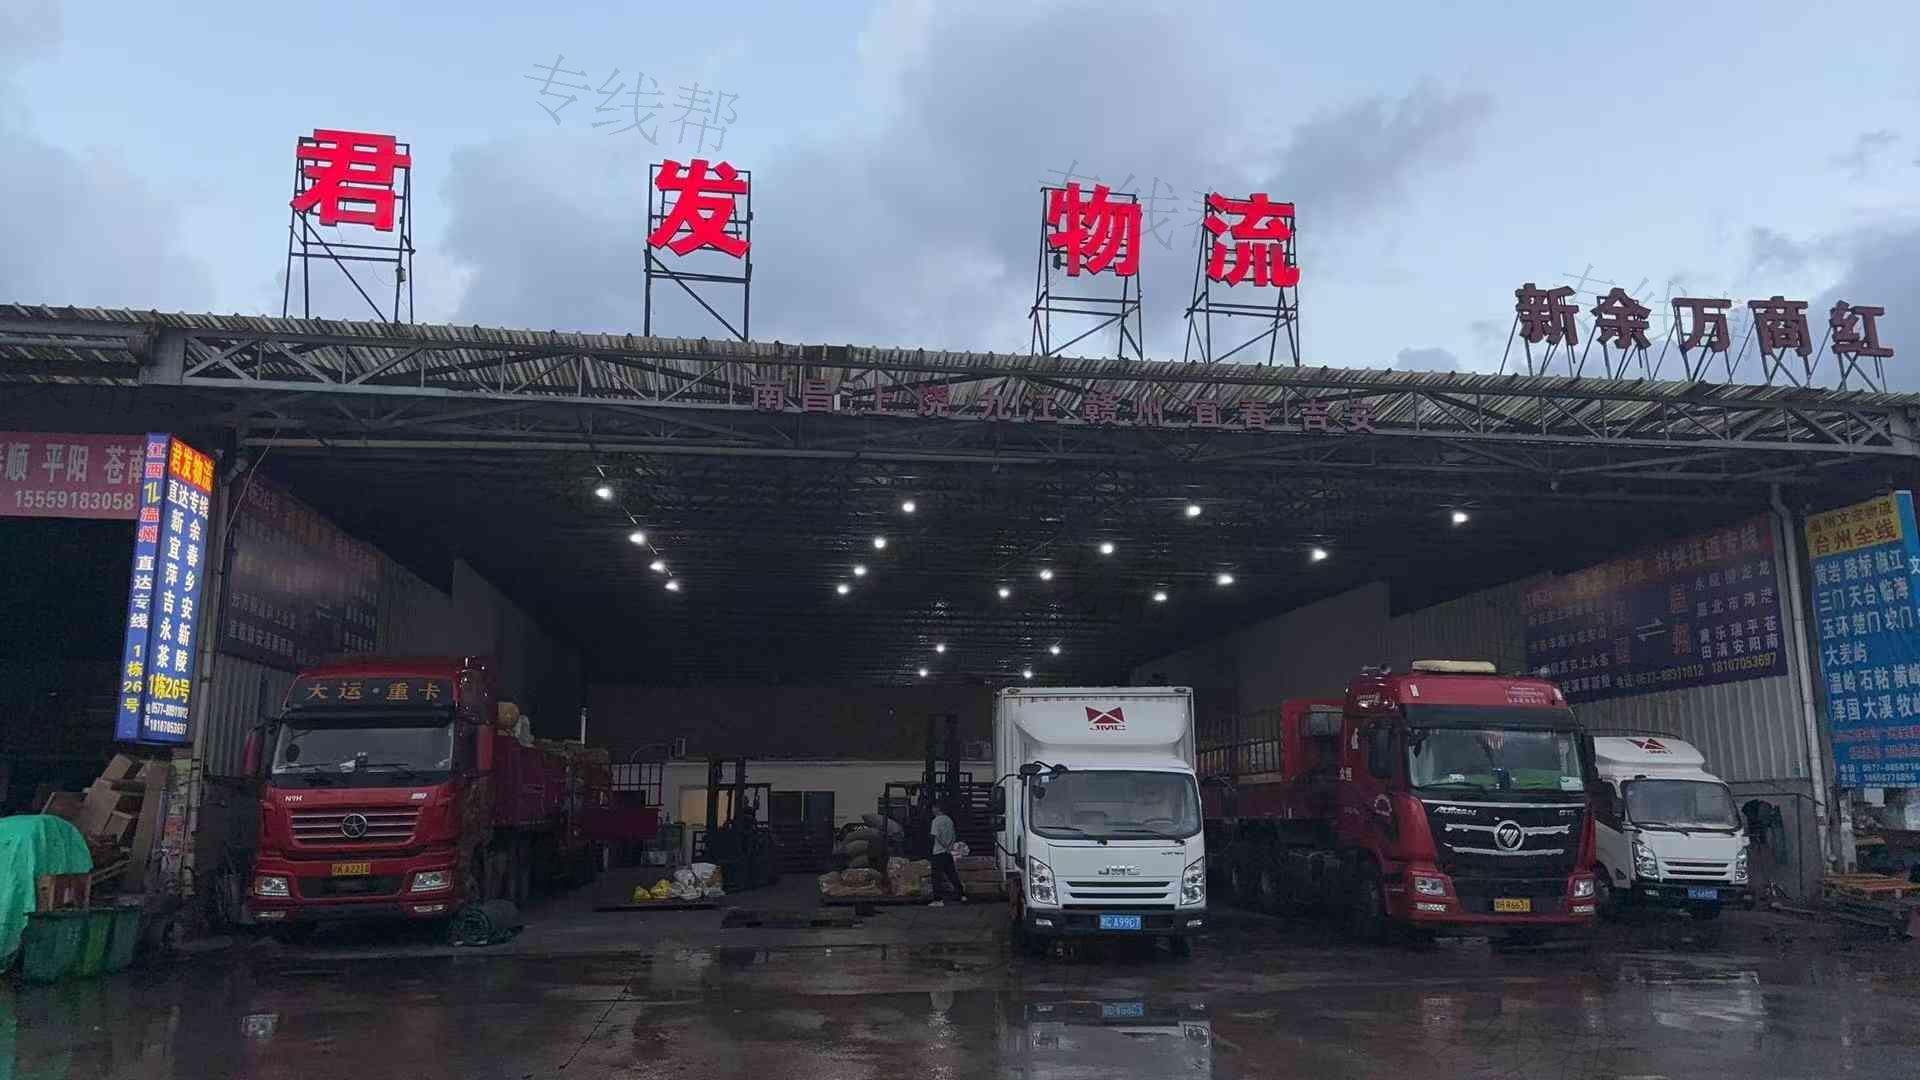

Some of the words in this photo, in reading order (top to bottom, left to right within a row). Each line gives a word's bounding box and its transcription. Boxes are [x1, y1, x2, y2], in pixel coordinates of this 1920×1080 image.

[42, 443, 89, 483] 平阳
[15, 490, 135, 511] 15559183058
[167, 478, 209, 519] 直达专线
[1815, 560, 1841, 585] 黄岩
[130, 554, 154, 629] 直达专线
[1819, 588, 1845, 613] 三门
[1849, 582, 1876, 608] 天台
[1823, 615, 1849, 641] 玉环
[1852, 611, 1881, 637] 楚门
[123, 643, 144, 713] 1栋26号
[147, 672, 191, 704] 1栋26号
[1829, 671, 1856, 695] 温岭
[1863, 695, 1894, 720] 大溪
[1098, 865, 1142, 876] JMC
